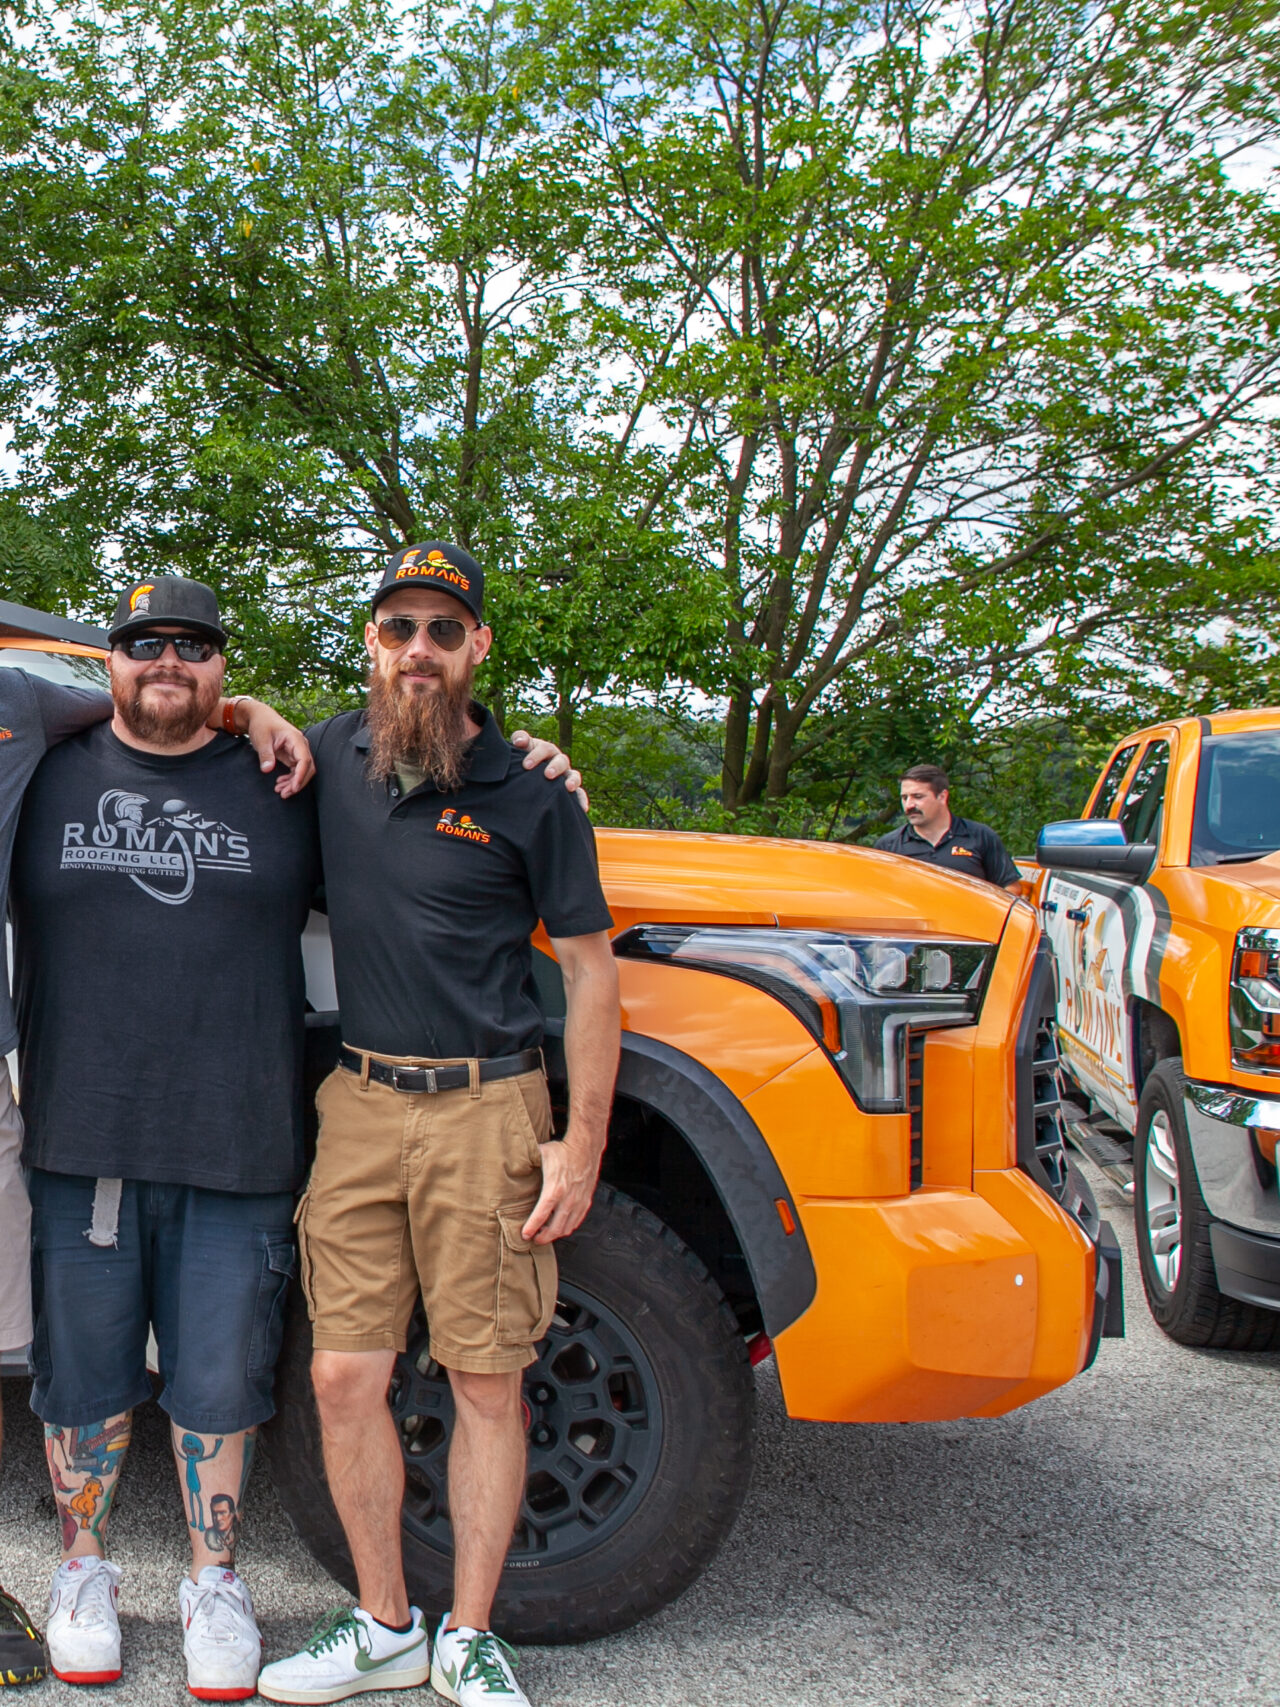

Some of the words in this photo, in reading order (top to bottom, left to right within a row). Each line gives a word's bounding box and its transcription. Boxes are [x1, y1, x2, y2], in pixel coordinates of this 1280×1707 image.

[395, 565, 470, 591] ROMAN'S
[63, 822, 250, 859] ROMAN'S
[65, 850, 140, 863] ROOFING
[150, 856, 178, 866] LLC
[59, 863, 117, 872] RENOVATIONS
[118, 866, 146, 875] SIDING
[148, 868, 185, 877] GUTTERS
